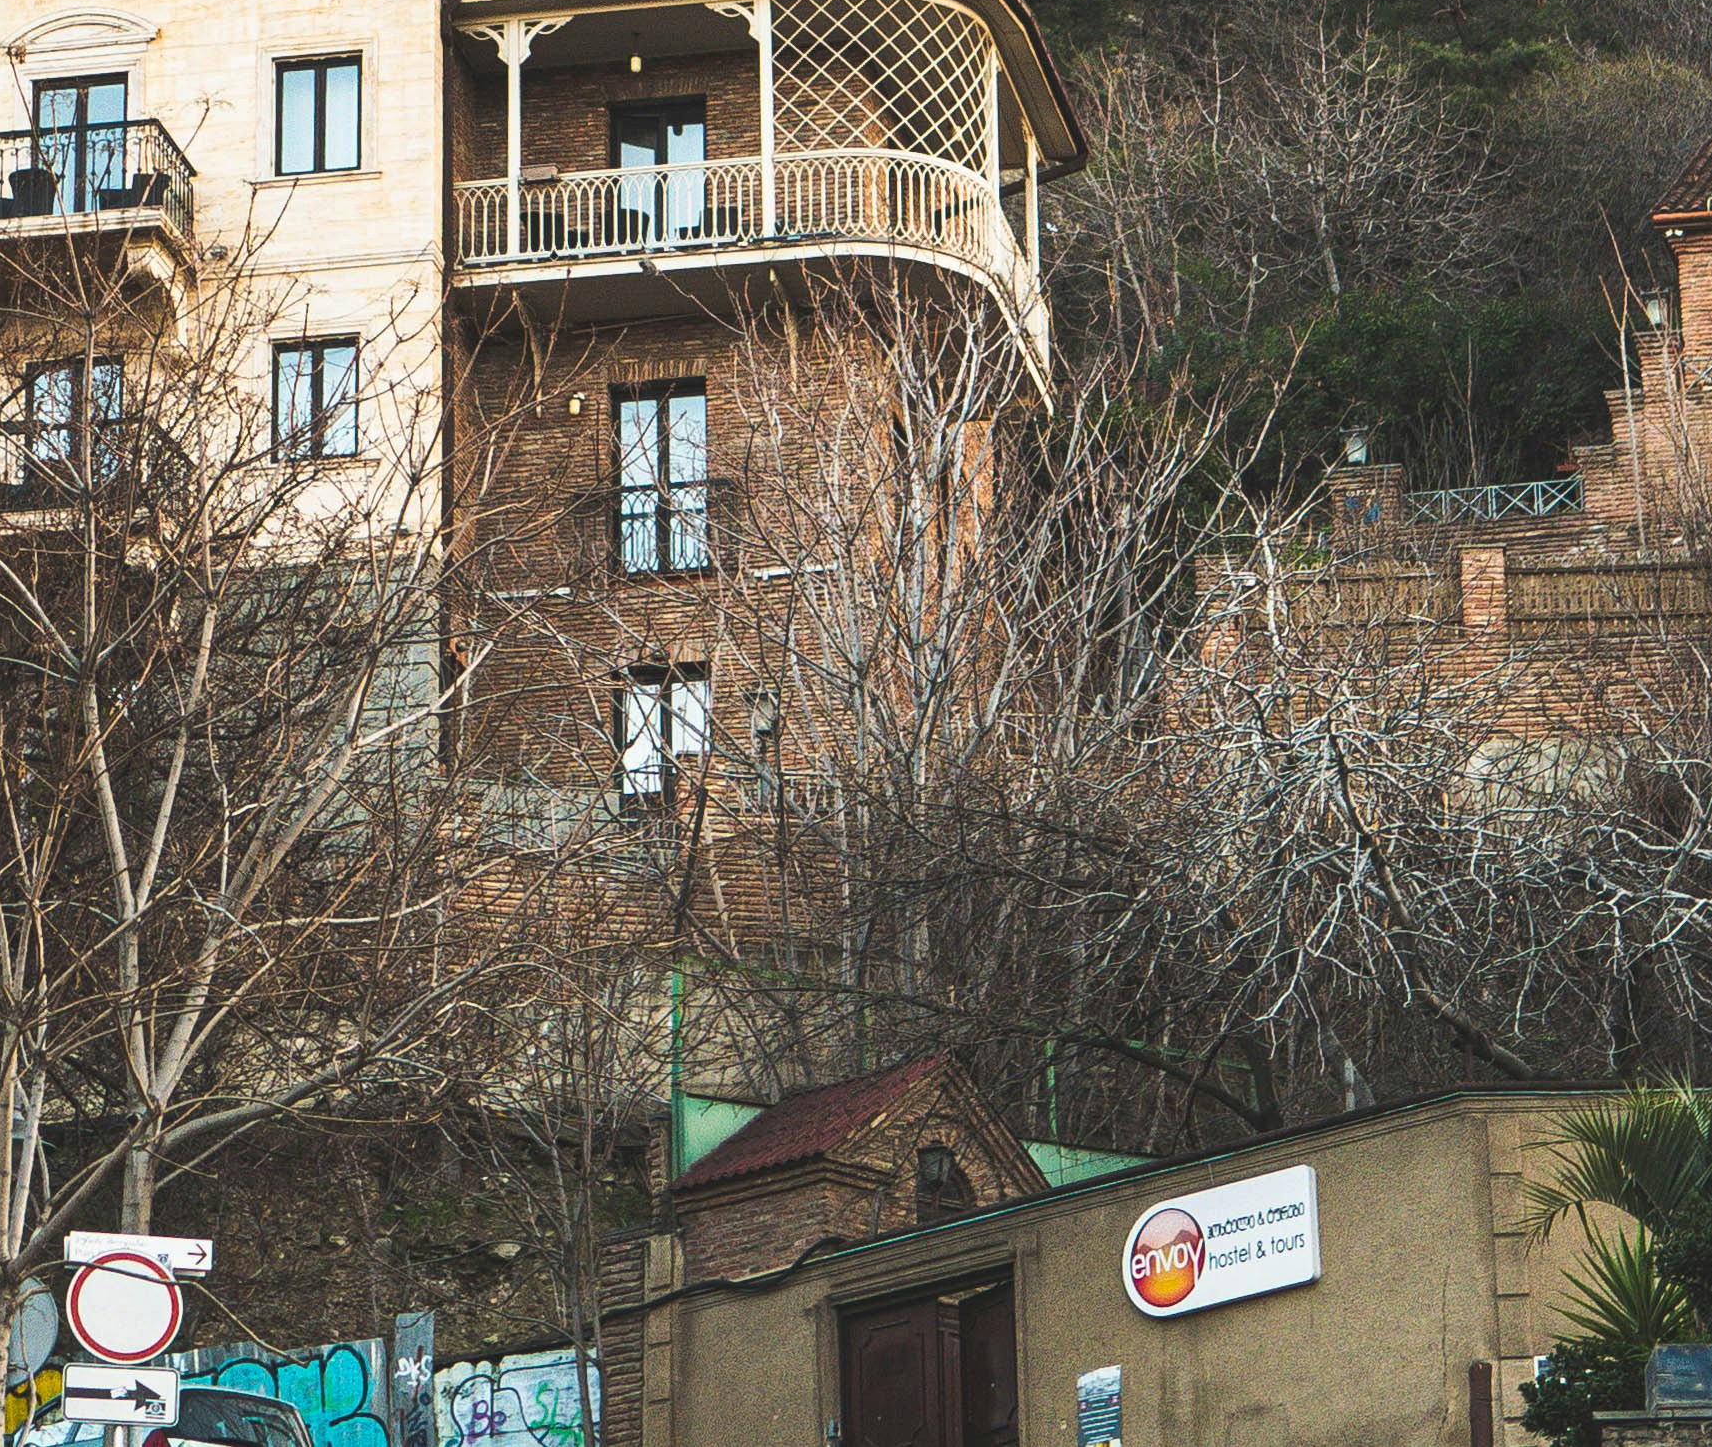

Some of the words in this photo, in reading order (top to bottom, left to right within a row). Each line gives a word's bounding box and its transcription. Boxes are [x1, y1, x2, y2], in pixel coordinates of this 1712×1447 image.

[1131, 1238, 1204, 1289] envoy
[1209, 1242, 1252, 1270] hostel
[1256, 1240, 1266, 1259] &
[1271, 1233, 1305, 1254] tours
